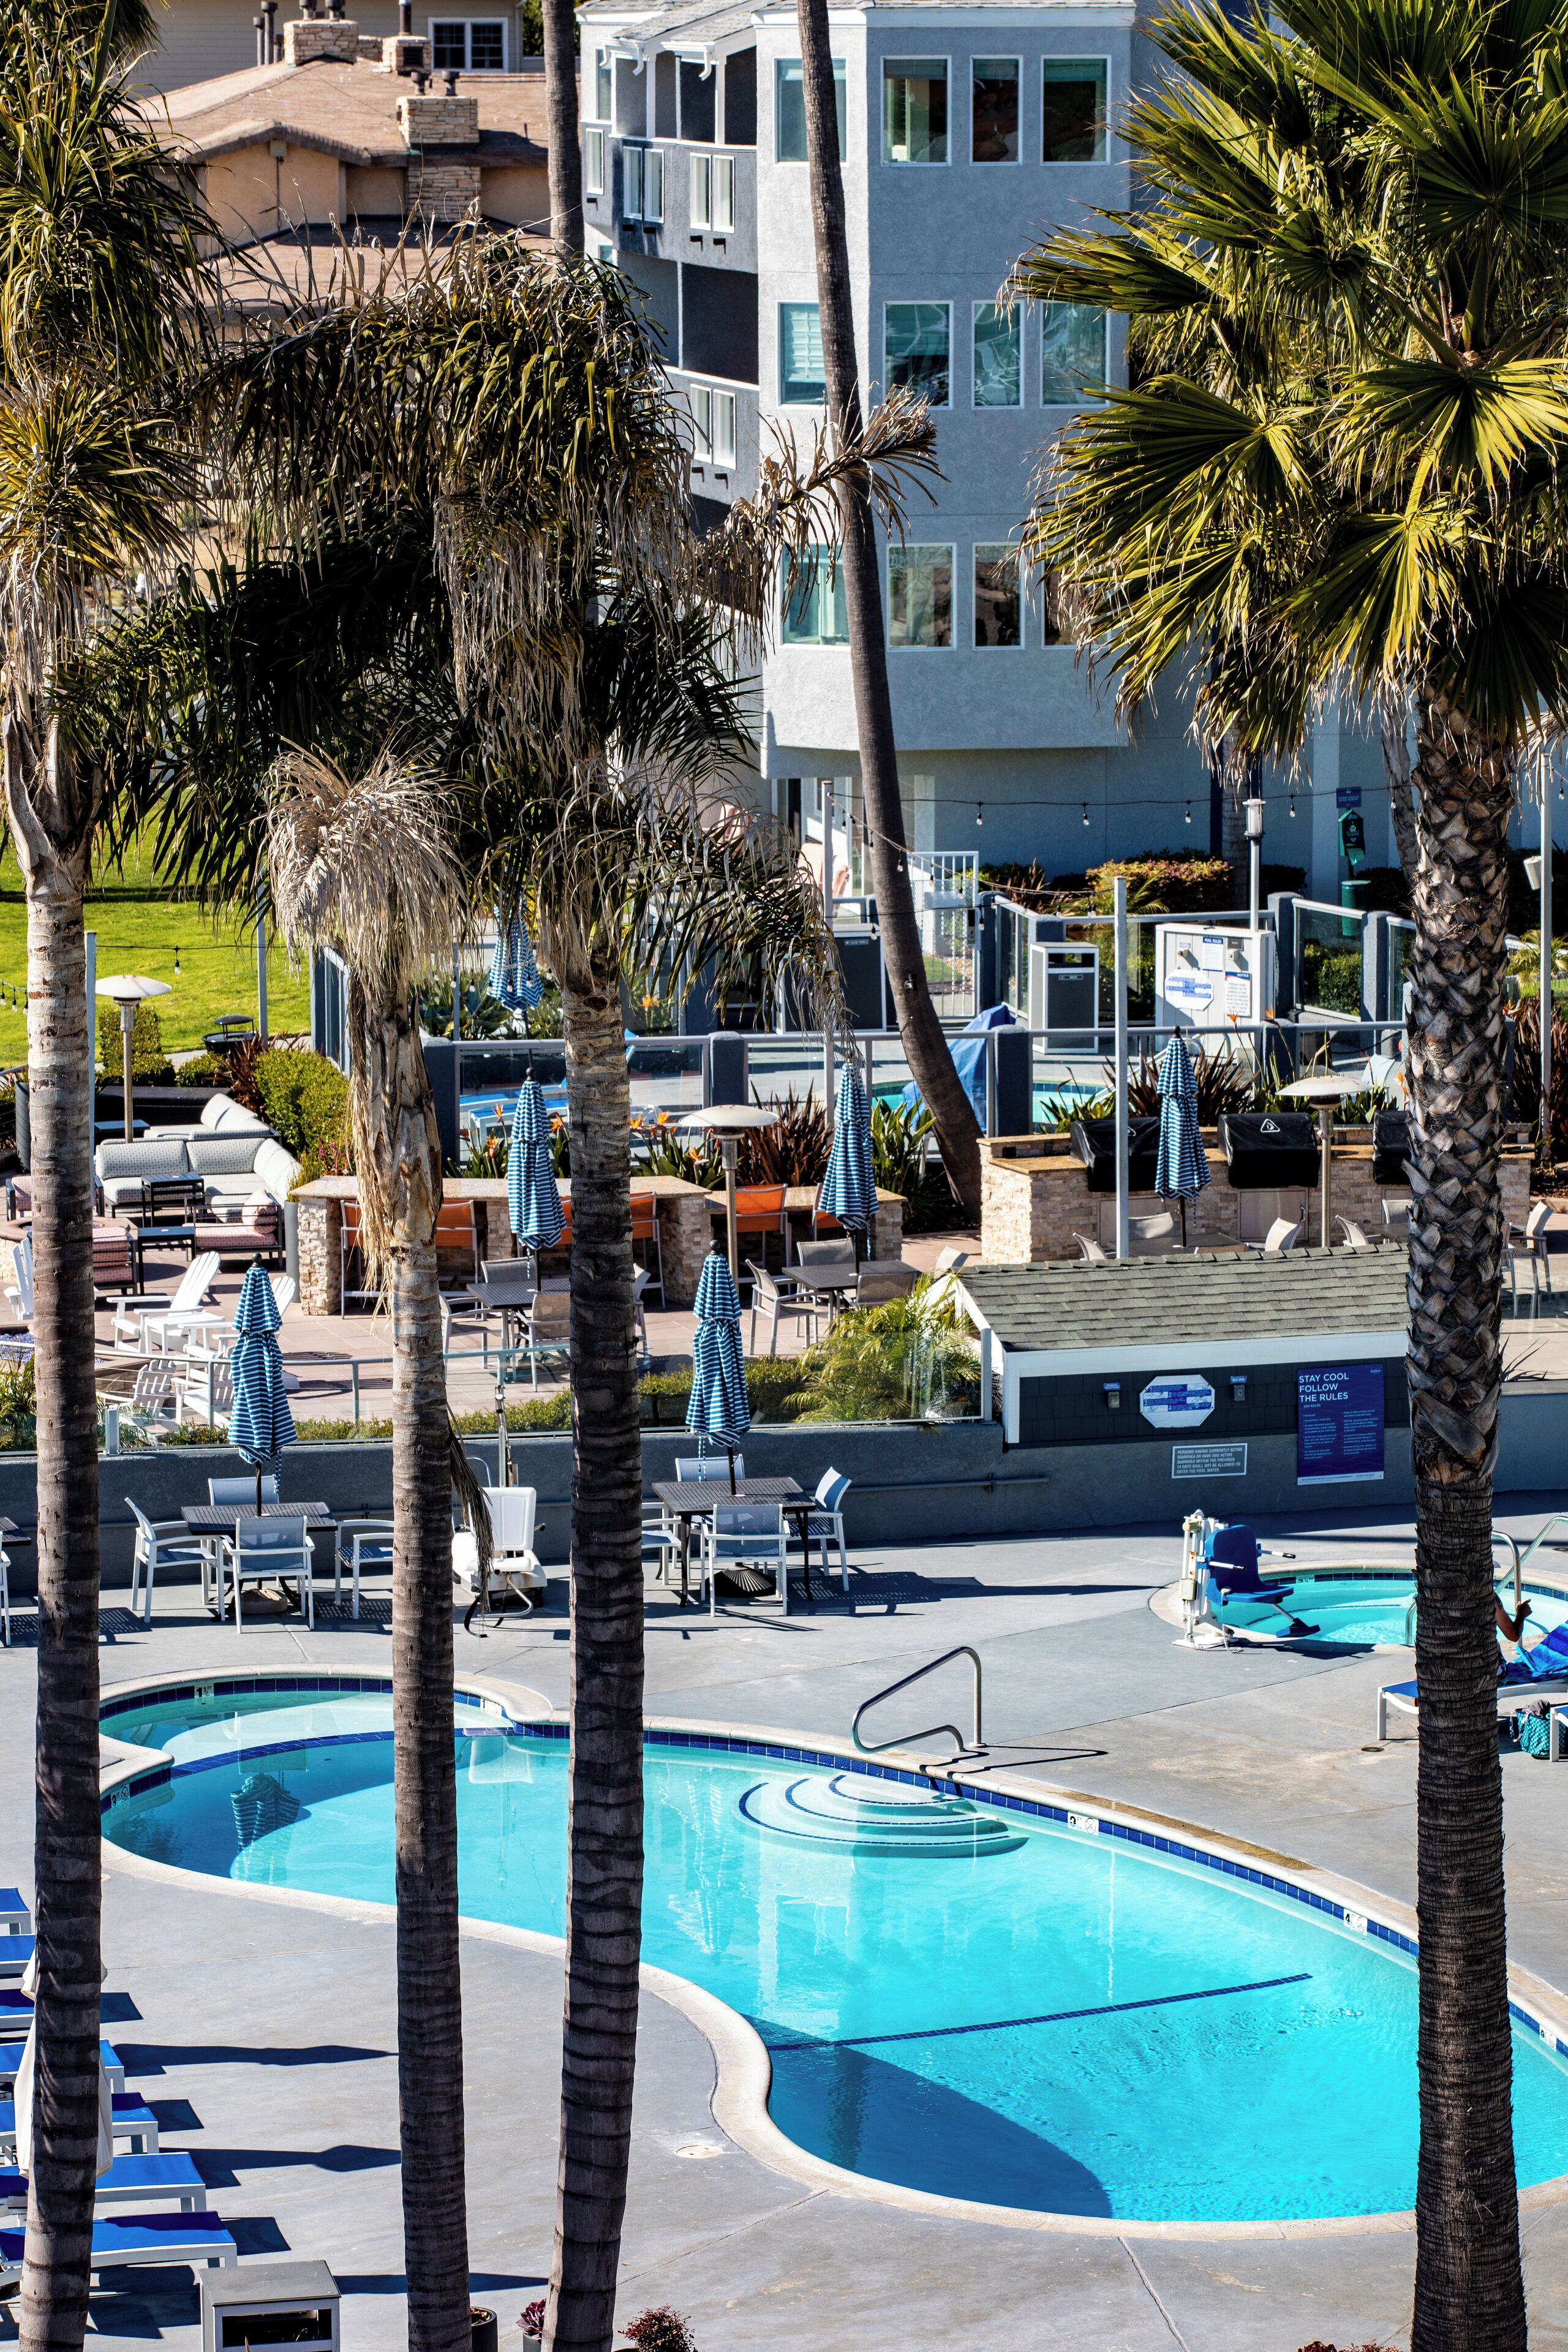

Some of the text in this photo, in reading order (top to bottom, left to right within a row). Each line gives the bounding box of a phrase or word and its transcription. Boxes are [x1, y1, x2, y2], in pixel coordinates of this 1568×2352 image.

[1299, 1372, 1349, 1383] STAY COOL
[1299, 1382, 1338, 1393] FOLLOW
[1299, 1392, 1348, 1403] THE RULES
